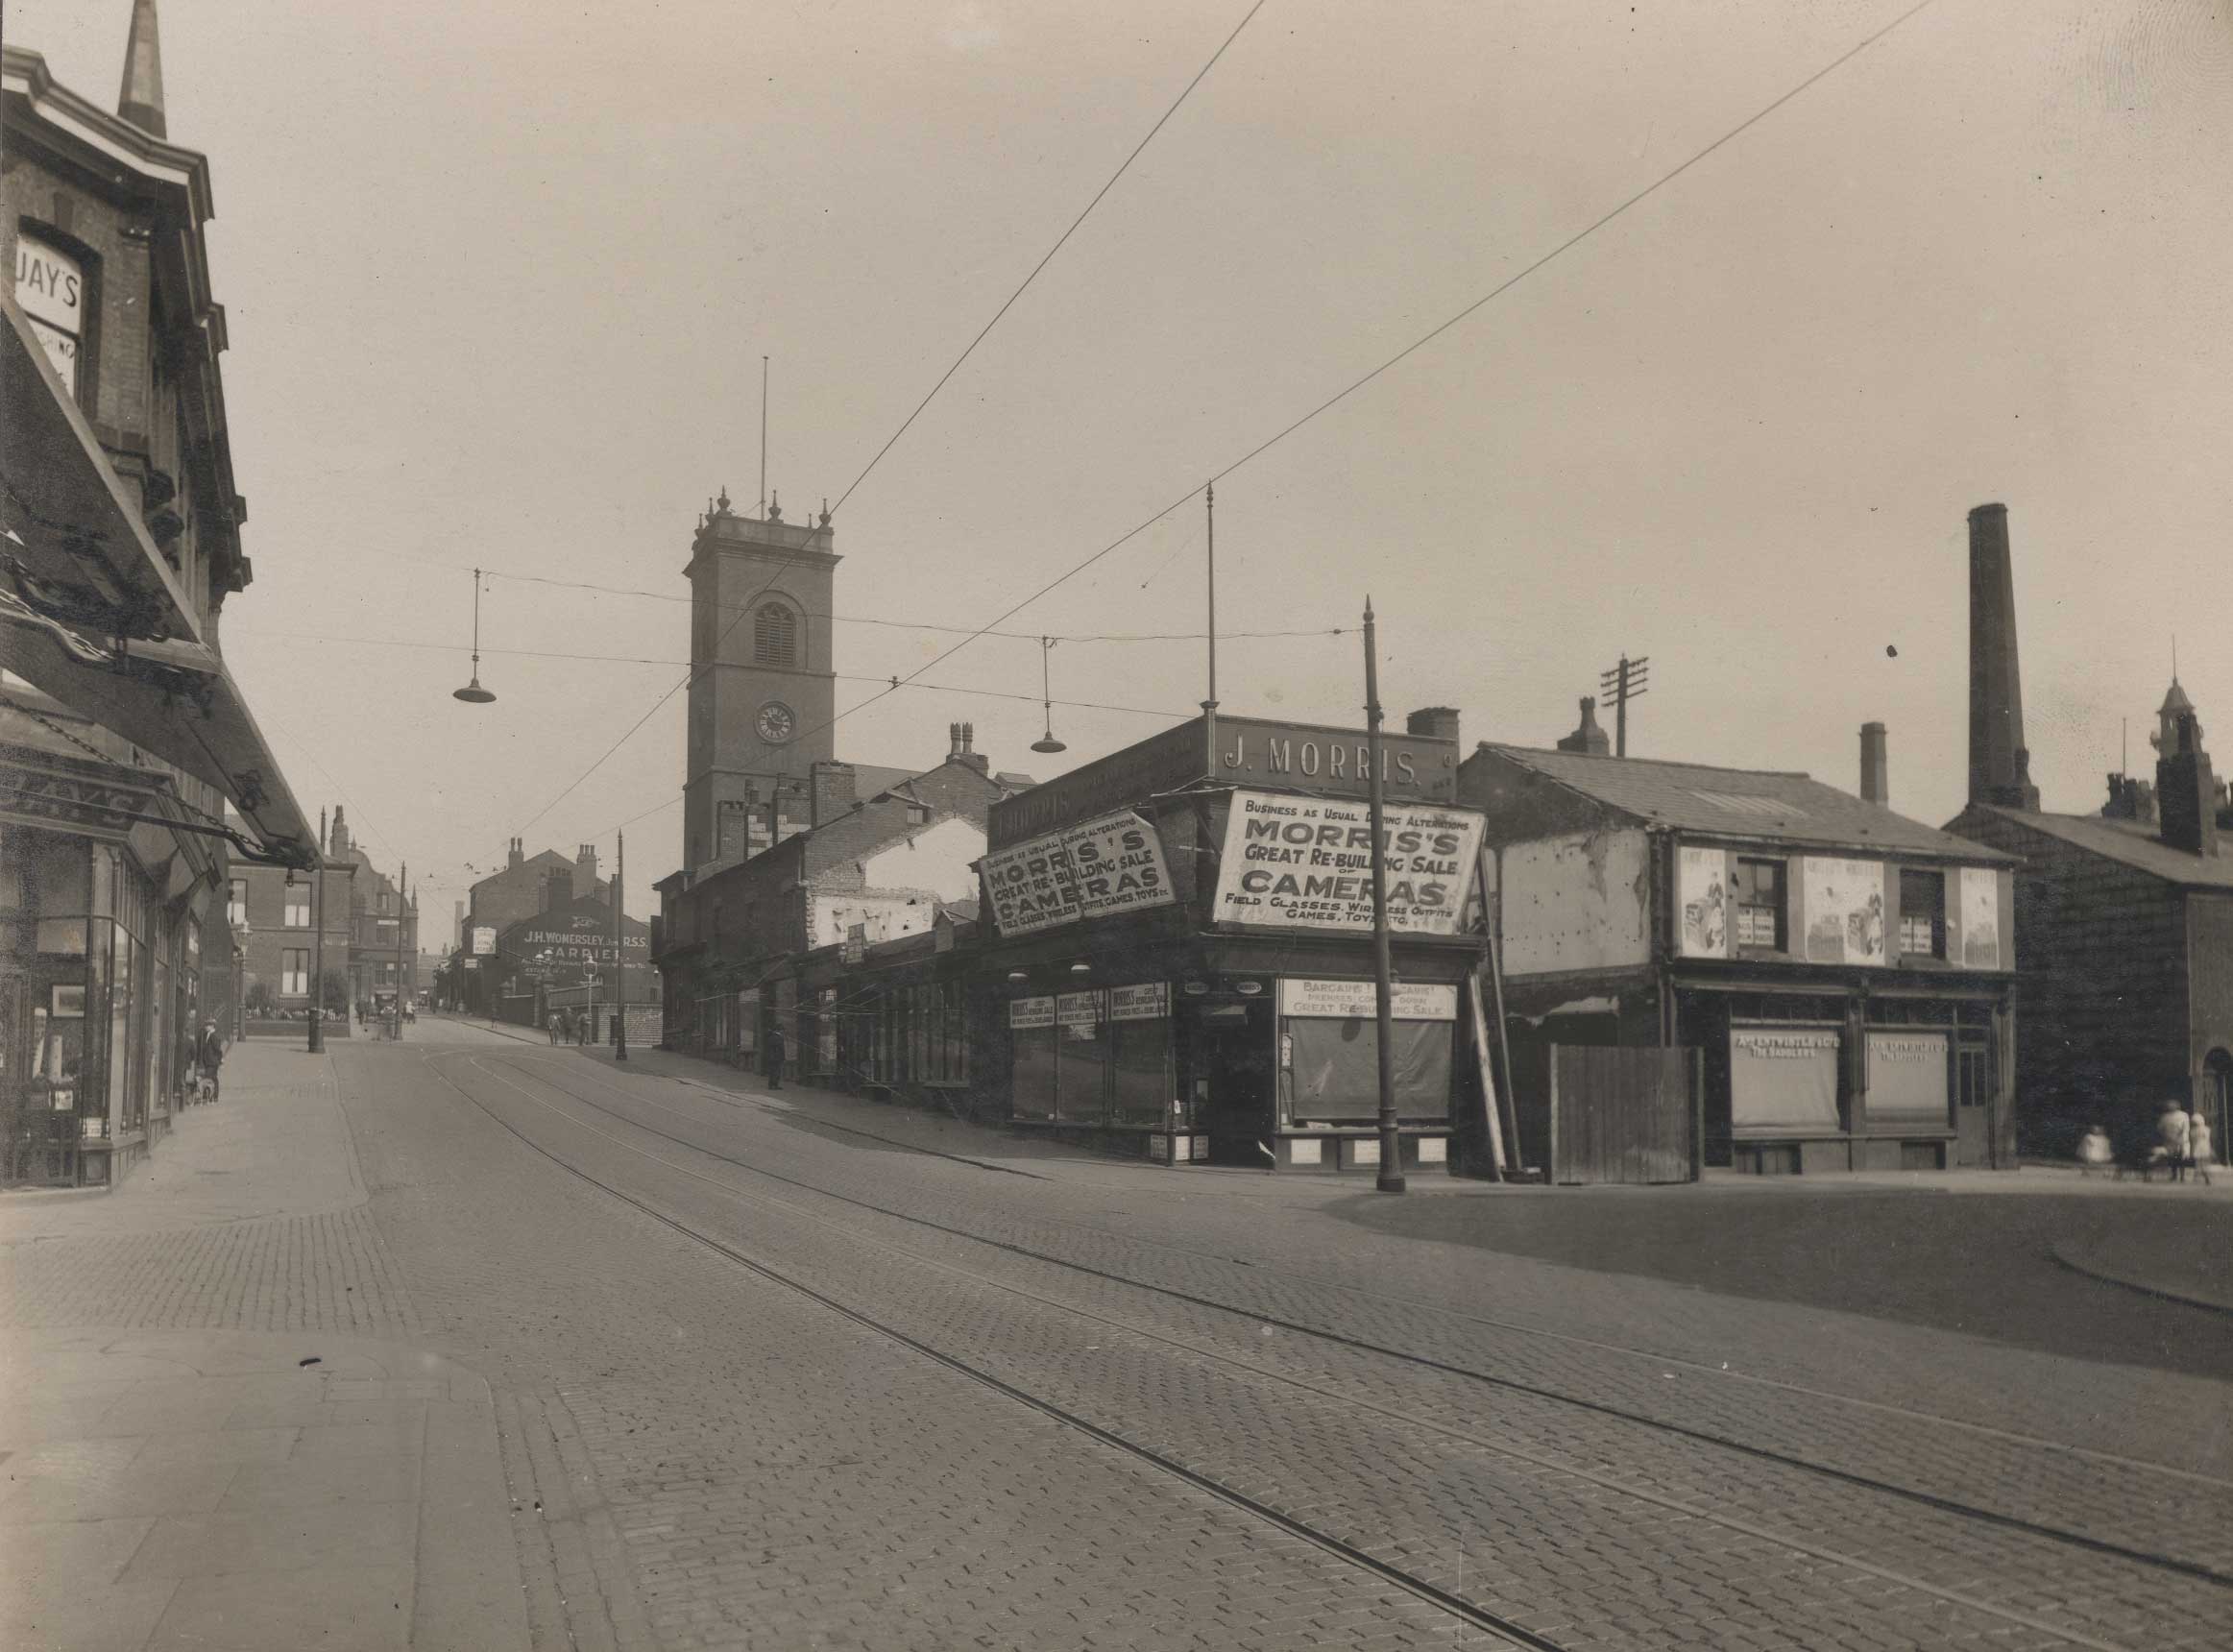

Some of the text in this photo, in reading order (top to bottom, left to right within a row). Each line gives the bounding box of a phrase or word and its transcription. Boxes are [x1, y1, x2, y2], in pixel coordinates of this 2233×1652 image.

[1245, 800, 1298, 816] BUSINESS
[1303, 809, 1319, 817] AS
[1324, 809, 1359, 821] USUAL
[1406, 815, 1469, 831] ALTERATIONS
[1028, 841, 1059, 856] USUAL
[1088, 818, 1137, 838] ALTERATIONS
[1245, 818, 1460, 856] MORRIS'S
[994, 882, 1030, 902] GREAT
[1119, 849, 1155, 869] SALE
[1245, 843, 1304, 863] GREAT
[1411, 856, 1458, 875] SALE
[999, 866, 1159, 920] CAMERAS
[1226, 893, 1262, 905] FIELD
[1411, 906, 1454, 917] OUTFITS
[1293, 1002, 1334, 1013] GREAT
[1413, 1007, 1444, 1016] SALE
